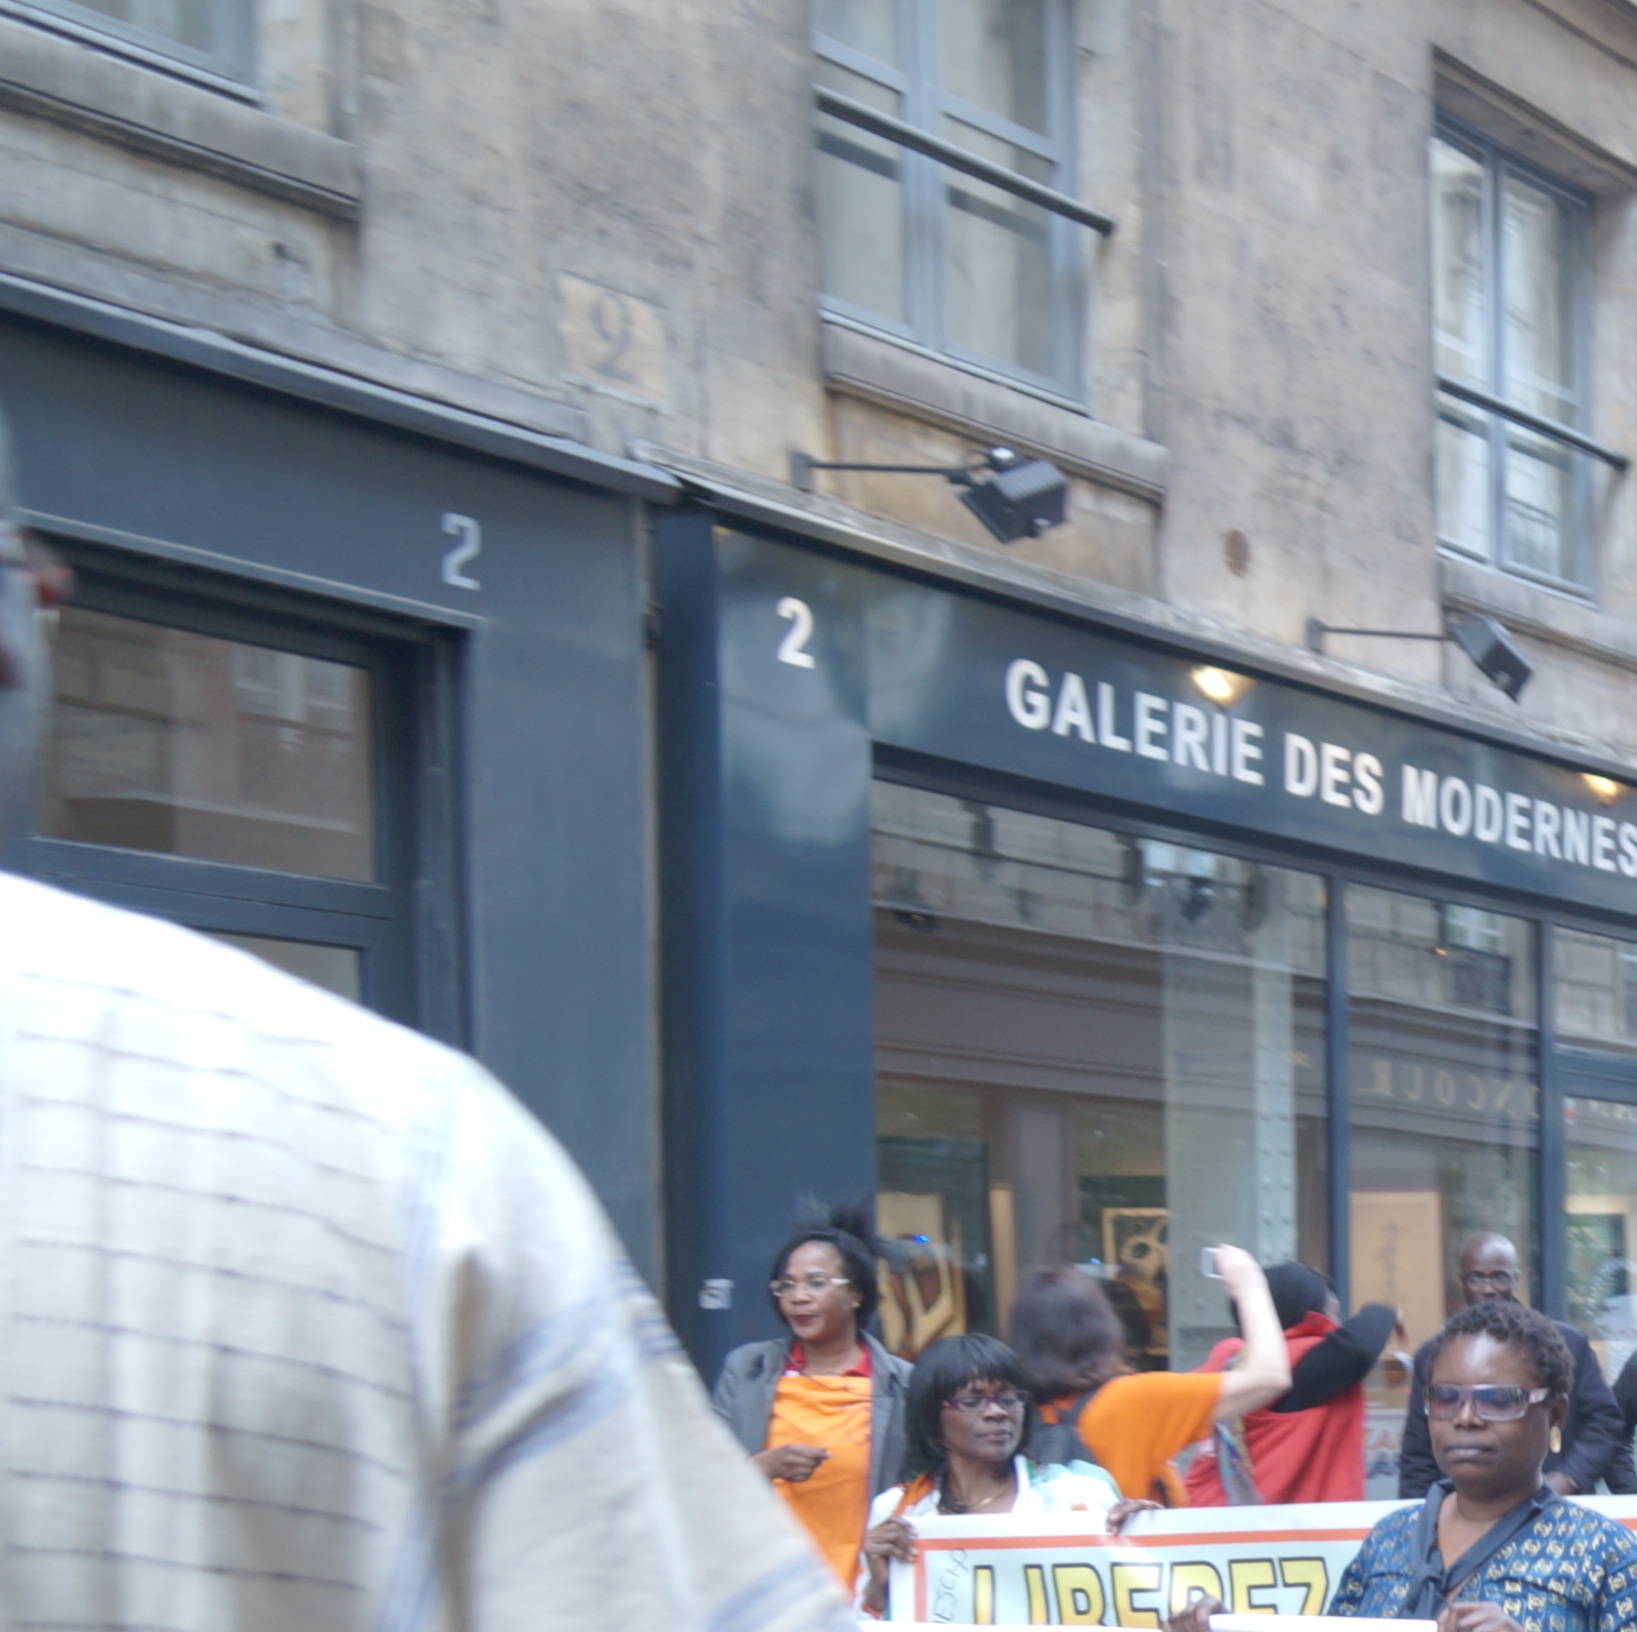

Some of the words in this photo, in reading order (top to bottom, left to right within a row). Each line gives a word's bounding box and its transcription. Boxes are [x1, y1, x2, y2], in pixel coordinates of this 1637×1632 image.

[441, 511, 483, 592] 2
[776, 596, 815, 669] 2
[1005, 658, 1266, 787] GALERIE
[1284, 731, 1384, 815] DES
